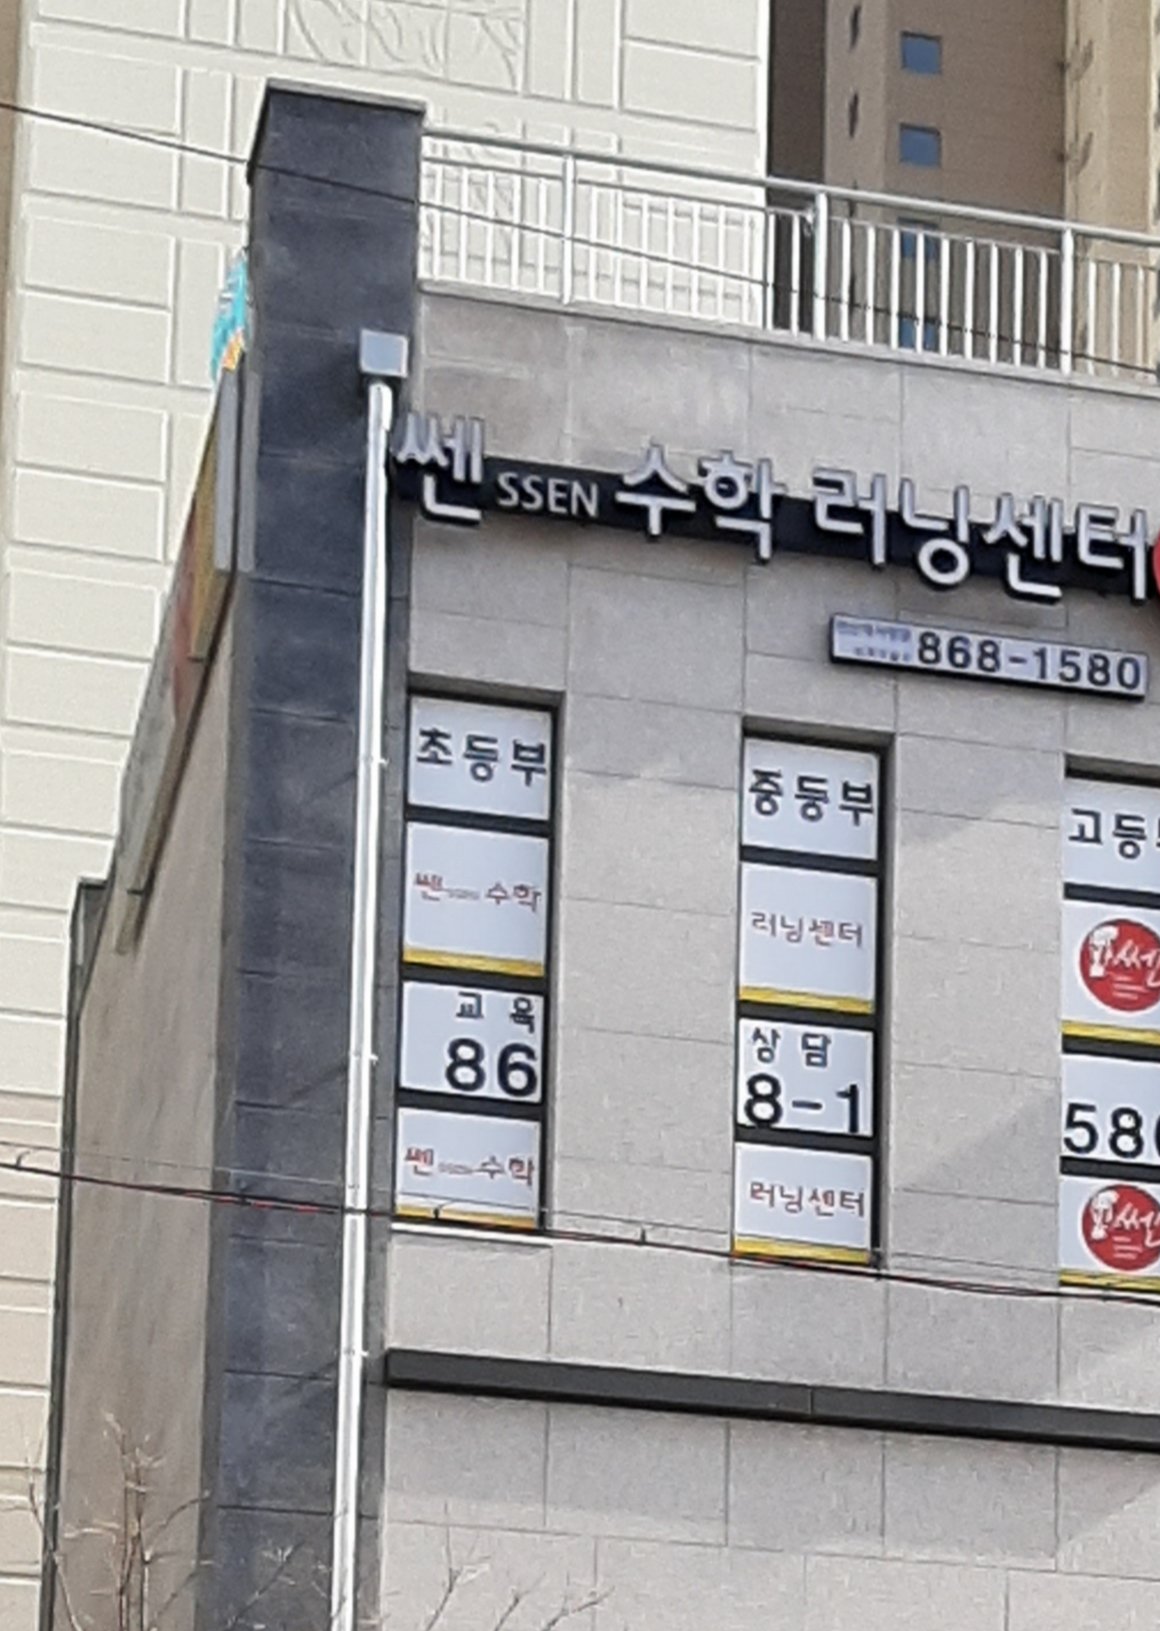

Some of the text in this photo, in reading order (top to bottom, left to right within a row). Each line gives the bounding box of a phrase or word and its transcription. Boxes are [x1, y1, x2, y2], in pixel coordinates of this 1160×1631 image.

[396, 411, 1147, 604] 쎈 SSEN 수학 러닝센터
[917, 631, 1141, 690] 868-1580
[416, 727, 547, 788] 초등부
[748, 769, 875, 828] 중등부
[485, 882, 542, 912] 수학
[750, 911, 863, 948] 러닝센터
[456, 992, 535, 1034] 교육
[445, 1038, 538, 1097] 86
[751, 1027, 832, 1069] 상담
[744, 1073, 860, 1133] 8-1
[750, 1182, 865, 1218] 러닝센터
